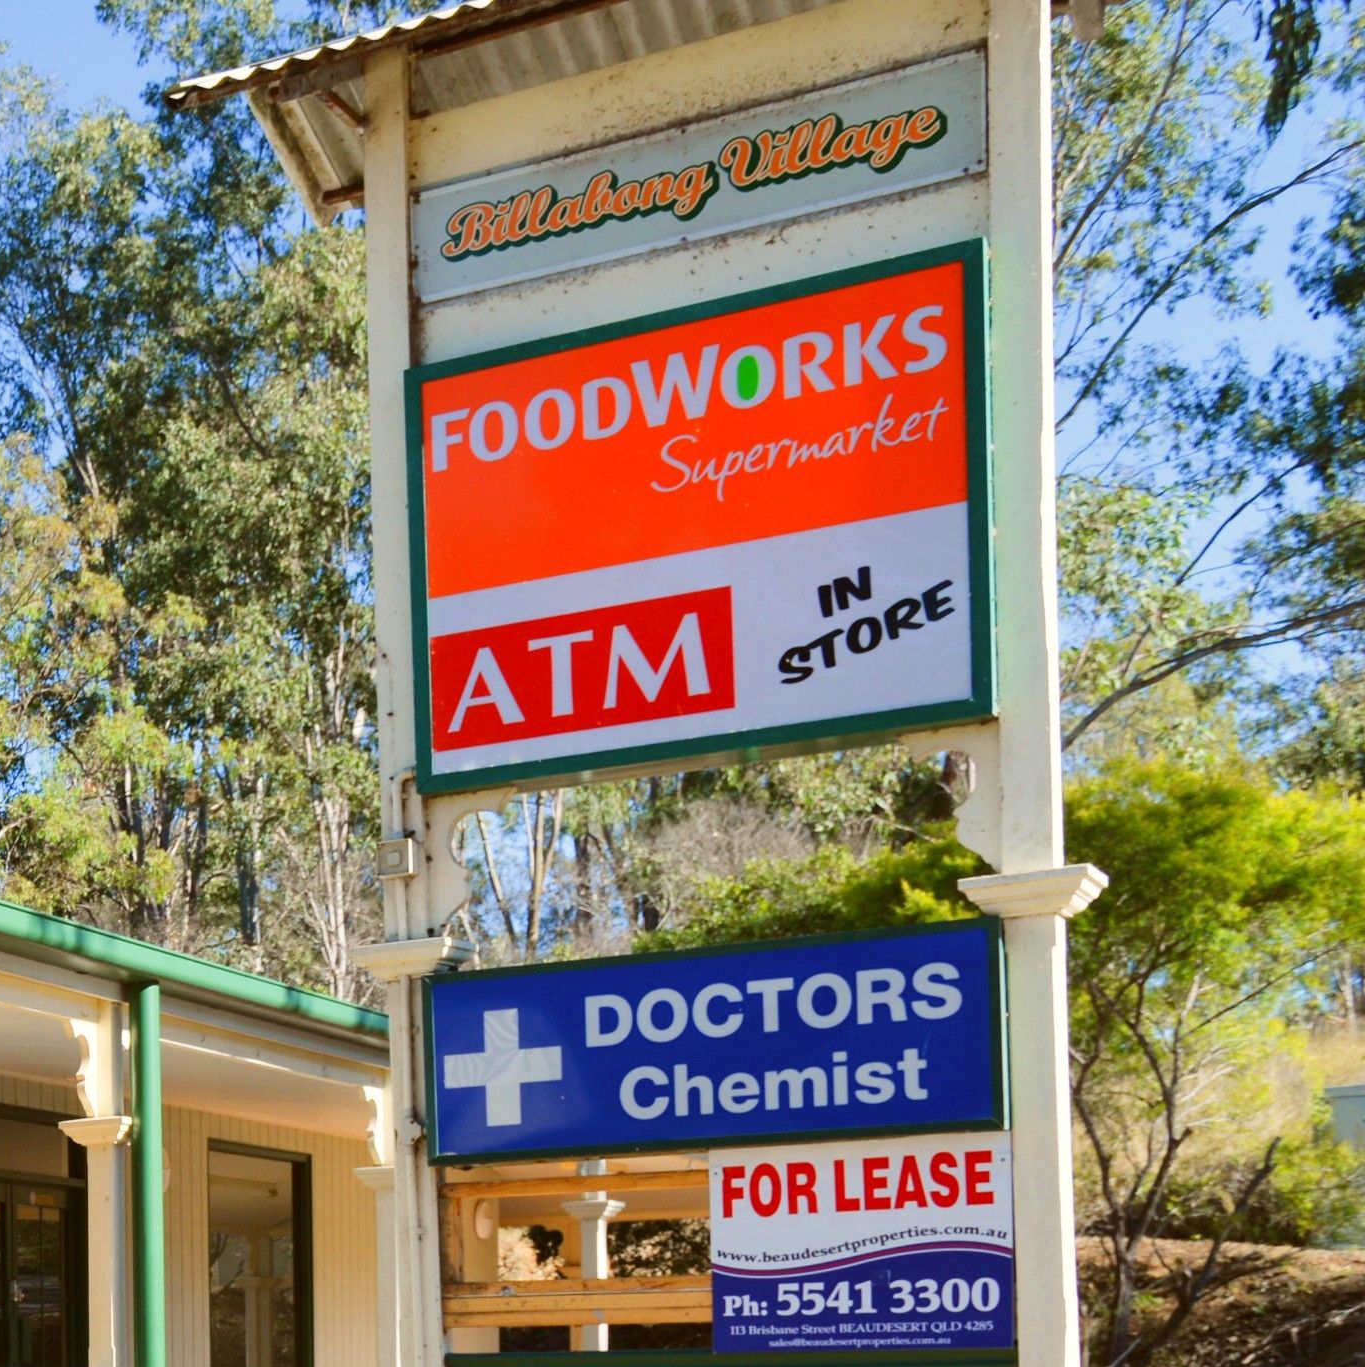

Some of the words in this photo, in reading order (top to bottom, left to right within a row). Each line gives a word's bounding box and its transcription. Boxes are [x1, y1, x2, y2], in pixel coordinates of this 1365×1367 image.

[441, 160, 716, 260] Billabong
[719, 105, 947, 186] Village
[430, 304, 948, 473] FOODWORKS
[650, 393, 948, 501] Supermarket
[778, 579, 955, 684] STORE
[817, 566, 871, 618] IN
[447, 612, 711, 733] ATM
[584, 961, 963, 1048] DOCTORS
[619, 1048, 928, 1120] Chemist
[721, 1161, 817, 1218] FOR
[833, 1150, 994, 1212] LEASE
[716, 1225, 1008, 1262] www.beaudesertproperties.com.au
[723, 1294, 768, 1317] Ph:
[776, 1280, 877, 1316] 5541
[889, 1277, 1000, 1314] 3300
[730, 1325, 746, 1336] 113
[749, 1325, 799, 1335] Brisbane
[801, 1324, 836, 1334] Street
[839, 1322, 929, 1333] BEAUDESERT
[930, 1321, 962, 1333] QLD
[964, 1320, 994, 1331] 4285
